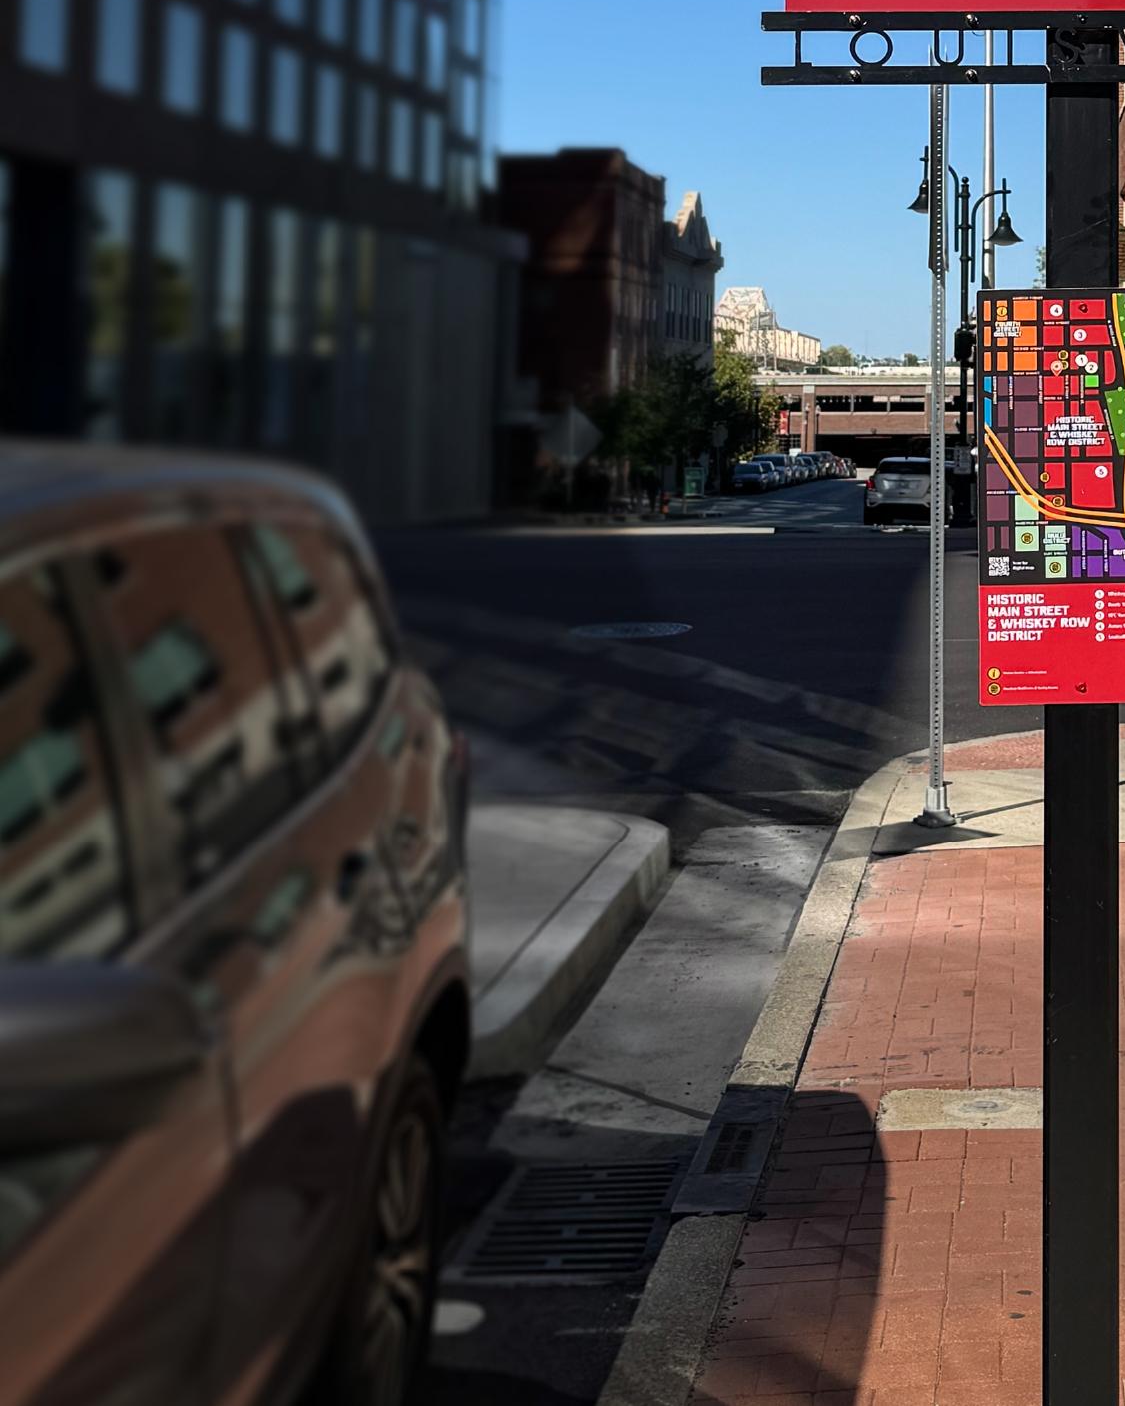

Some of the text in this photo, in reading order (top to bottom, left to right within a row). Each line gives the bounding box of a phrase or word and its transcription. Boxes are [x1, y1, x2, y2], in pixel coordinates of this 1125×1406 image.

[988, 594, 1044, 605] HISTORIC
[988, 605, 1070, 617] MAIN STREET
[988, 617, 1090, 629] & WHISKEY ROW
[988, 631, 1043, 641] DISTRICT
